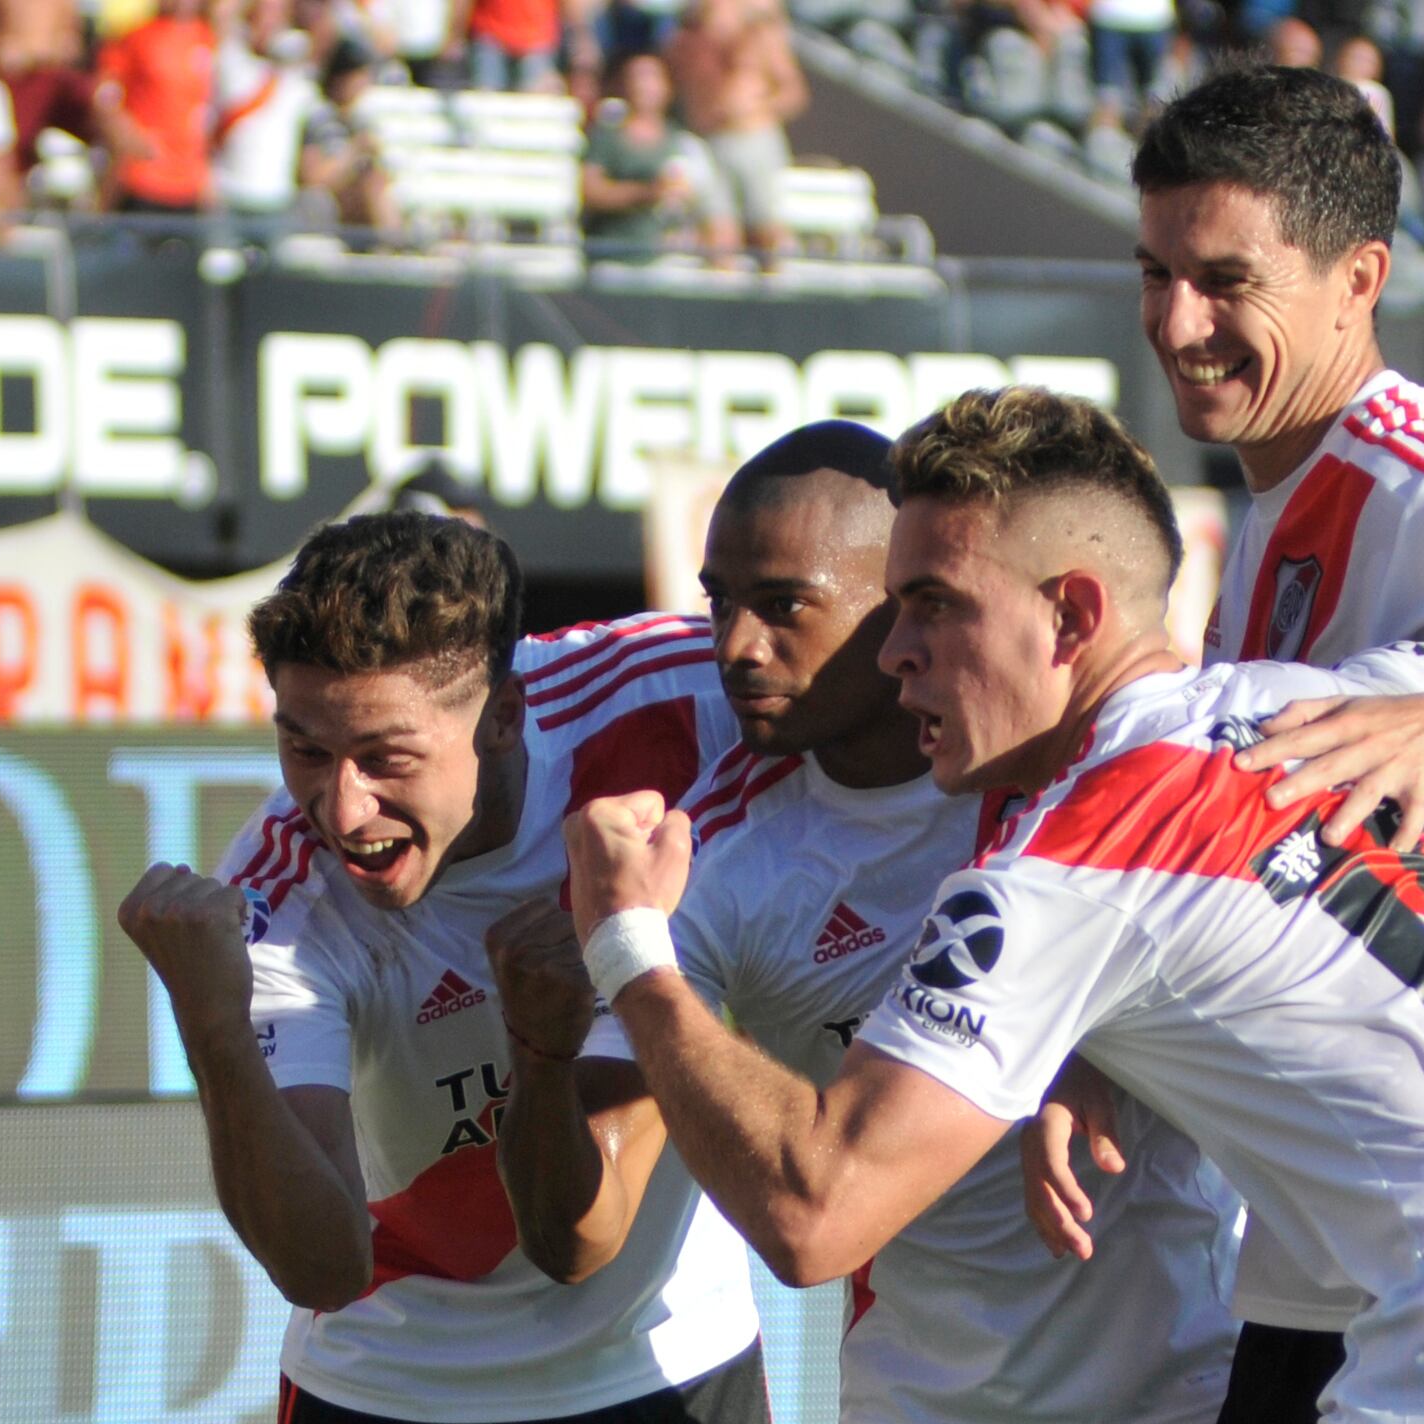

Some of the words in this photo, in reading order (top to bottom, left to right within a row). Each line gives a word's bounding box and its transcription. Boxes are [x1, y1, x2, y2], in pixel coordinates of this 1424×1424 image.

[812, 926, 887, 965] adidas
[415, 987, 487, 1025] adidas
[921, 1018, 978, 1049] energy
